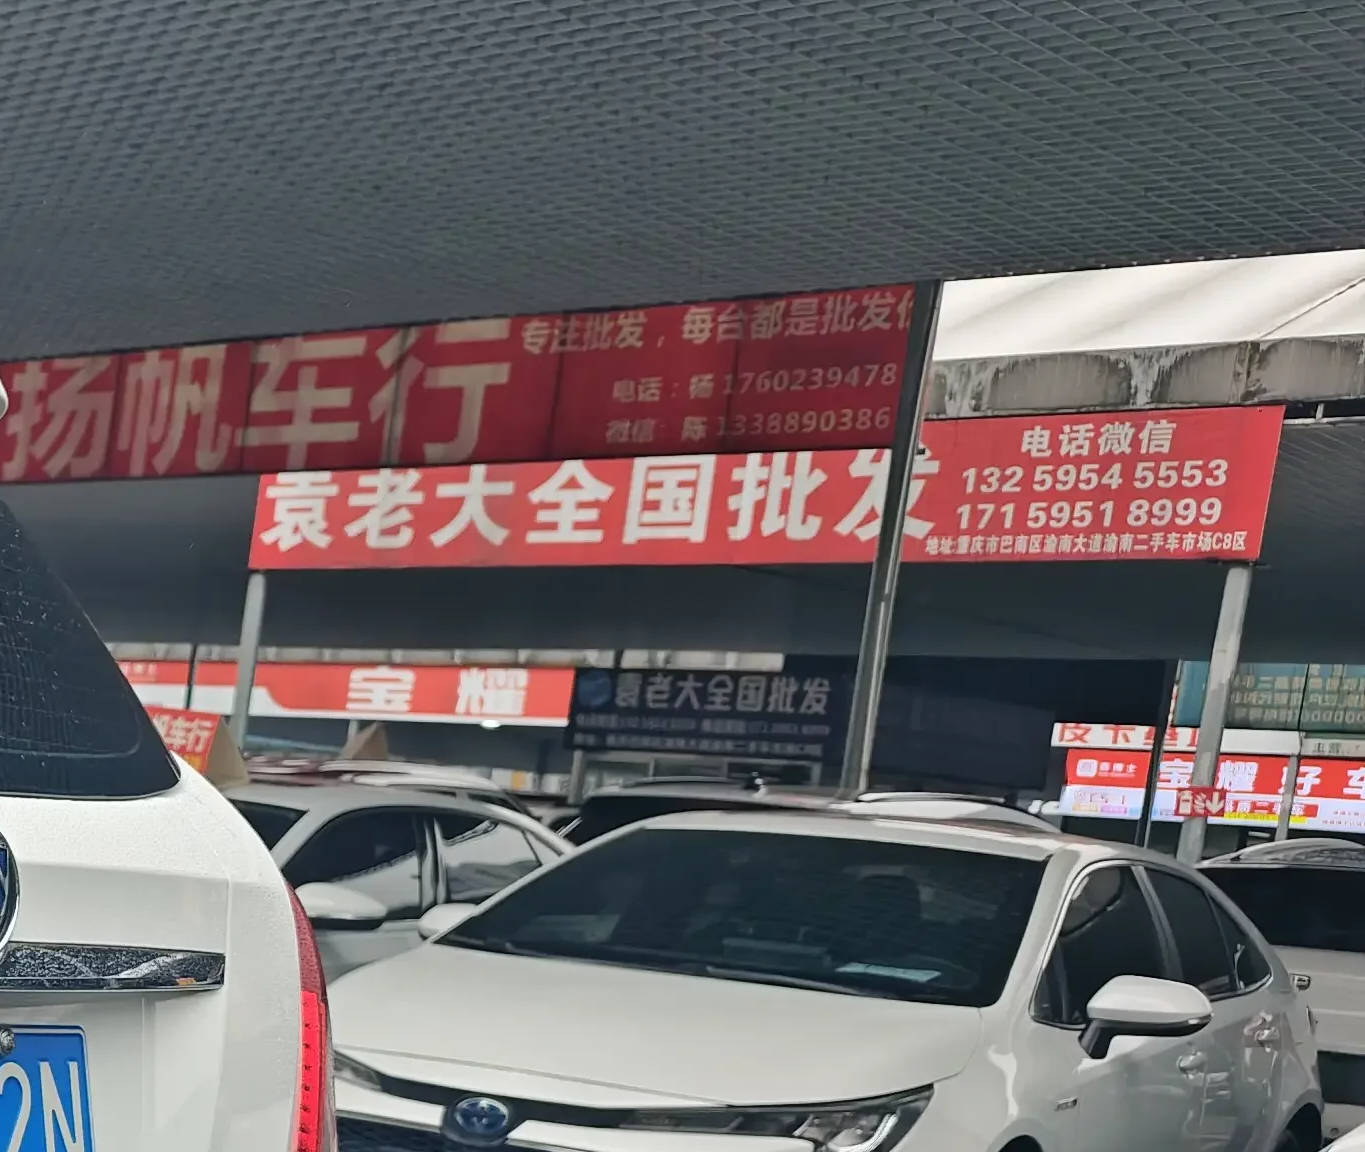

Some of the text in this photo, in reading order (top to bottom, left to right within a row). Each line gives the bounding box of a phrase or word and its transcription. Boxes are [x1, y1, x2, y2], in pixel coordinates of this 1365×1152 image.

[1, 318, 512, 481] 扬帆车行
[1020, 420, 1177, 458] 电话微信
[962, 459, 1229, 495] 132 5954 5553
[259, 449, 941, 552] 袁老大全国批发
[956, 497, 1222, 530] 171 5951 8999
[346, 665, 528, 716] 宝耀
[614, 672, 832, 715] 袁老大全国批发
